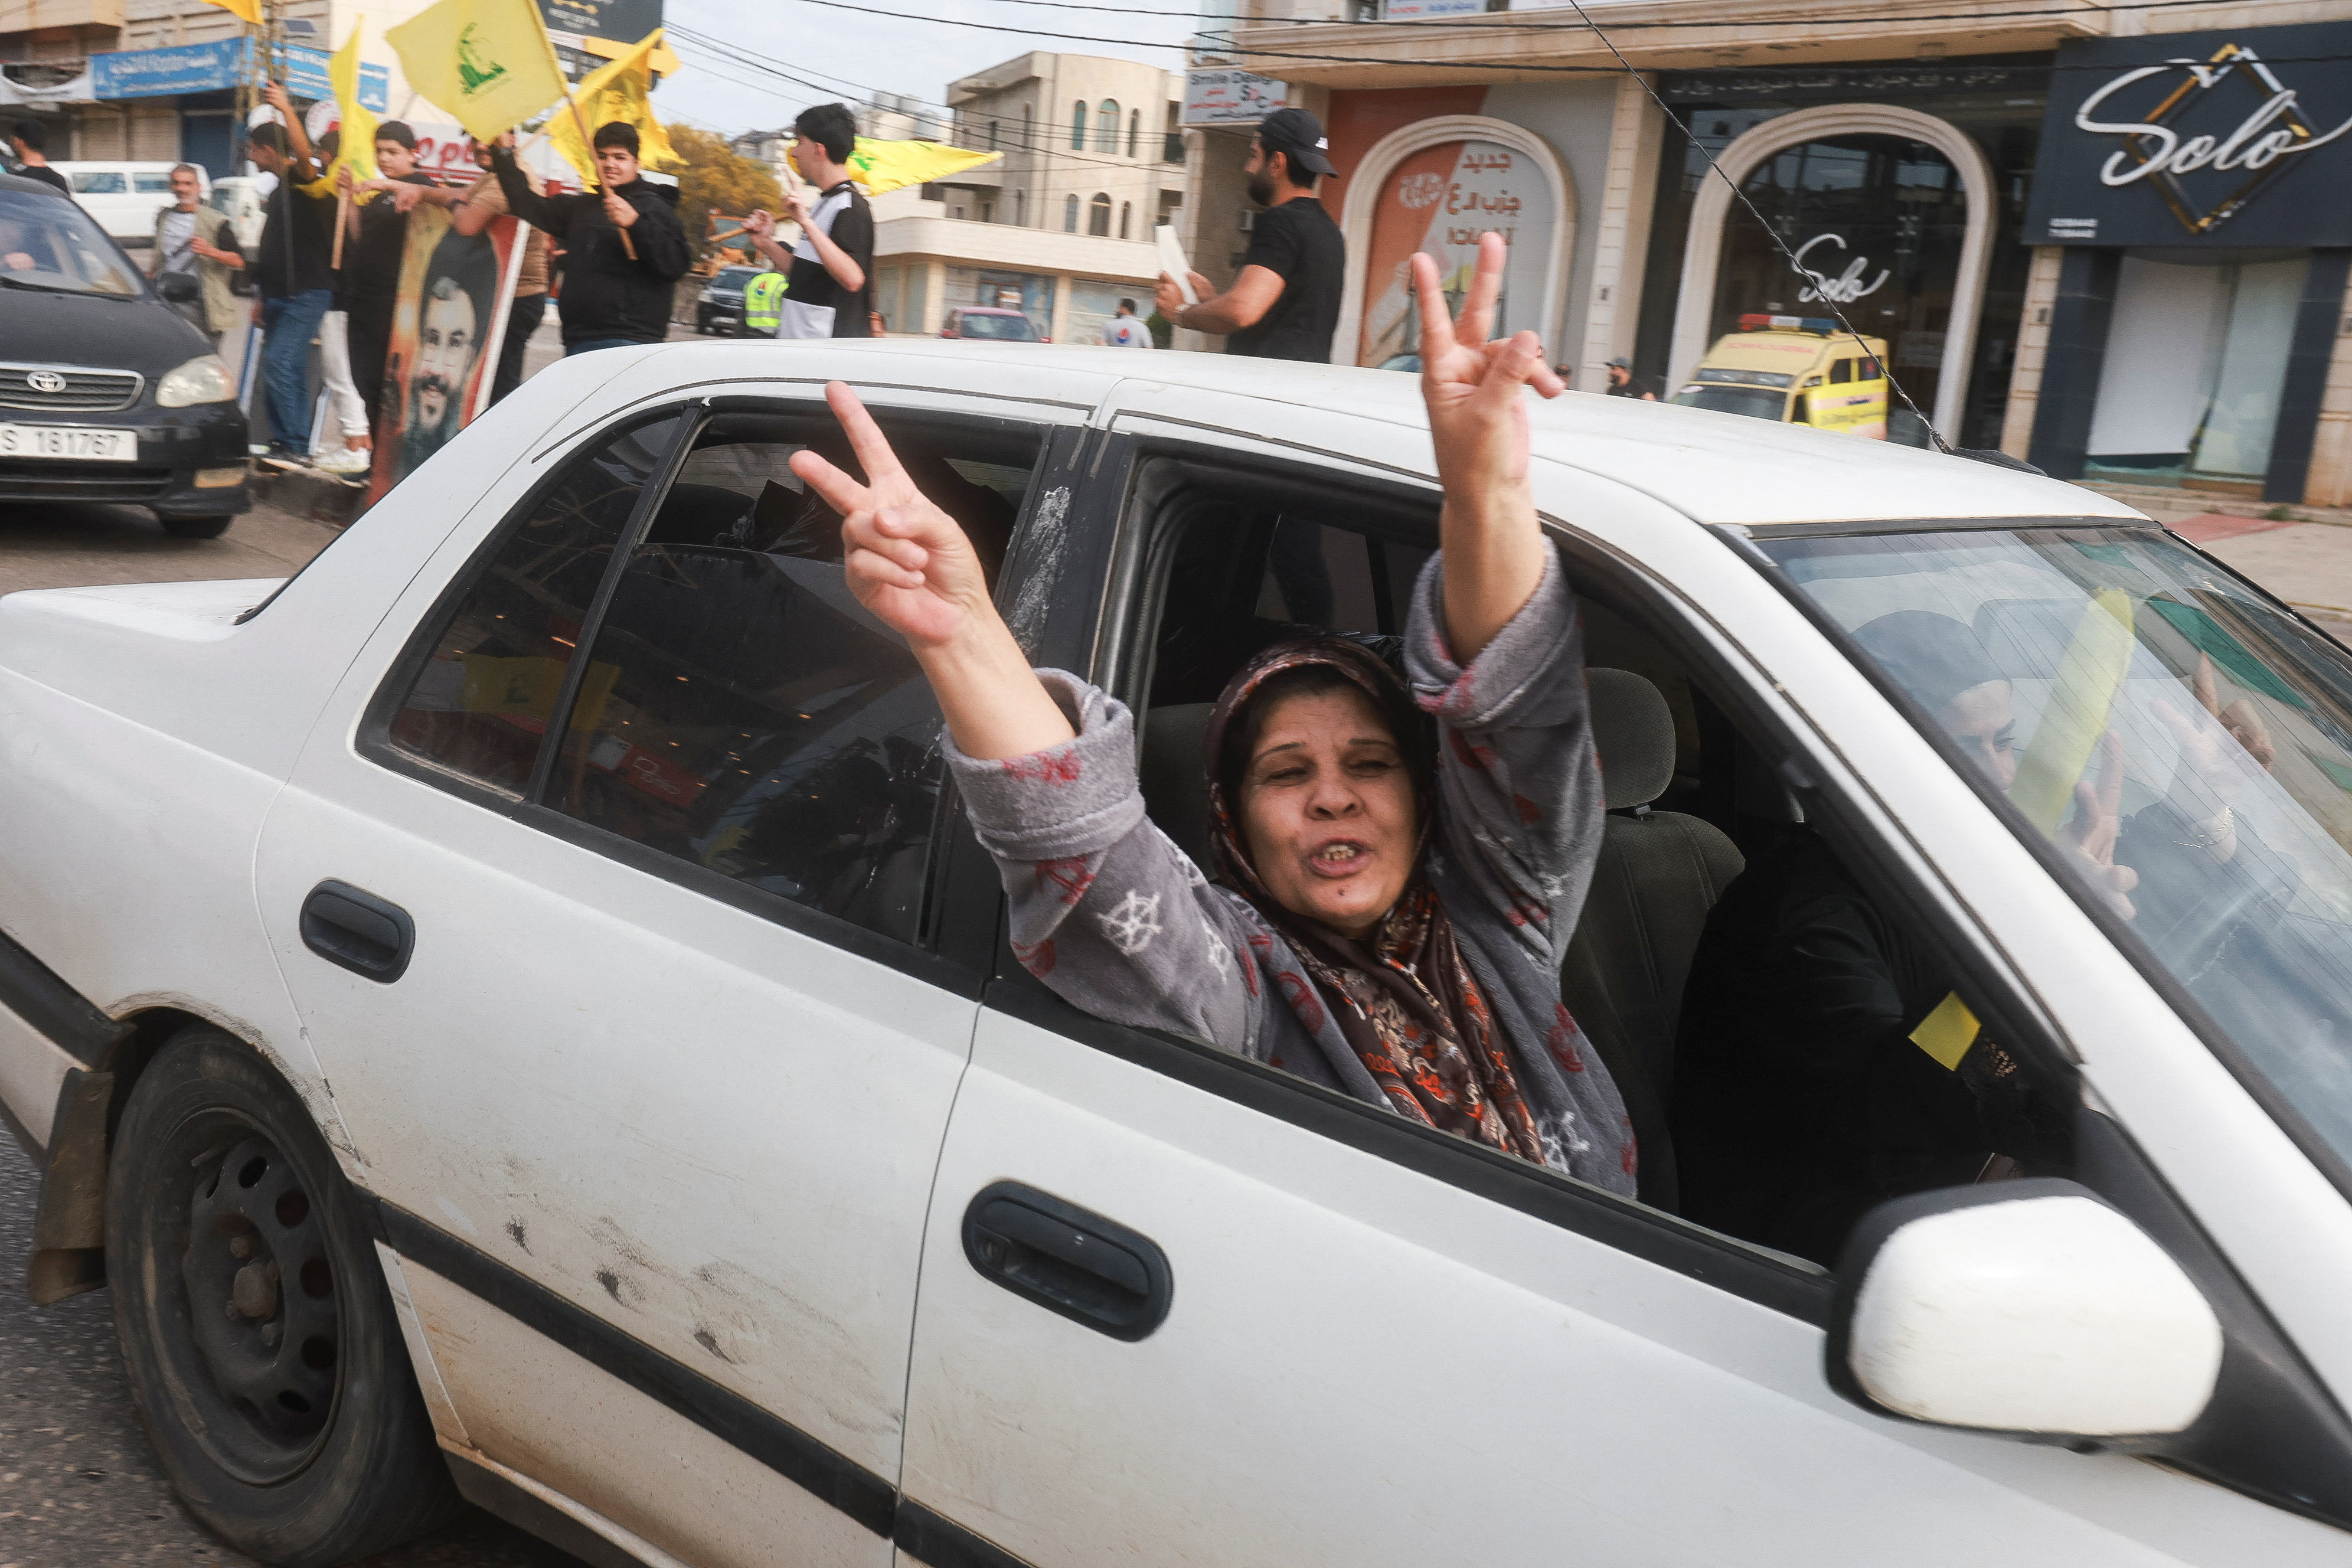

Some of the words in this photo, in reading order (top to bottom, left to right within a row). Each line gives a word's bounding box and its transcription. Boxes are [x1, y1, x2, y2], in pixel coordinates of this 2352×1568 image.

[1190, 73, 1228, 85] Smile
[2075, 58, 2352, 186] Solo
[2, 426, 18, 452] S
